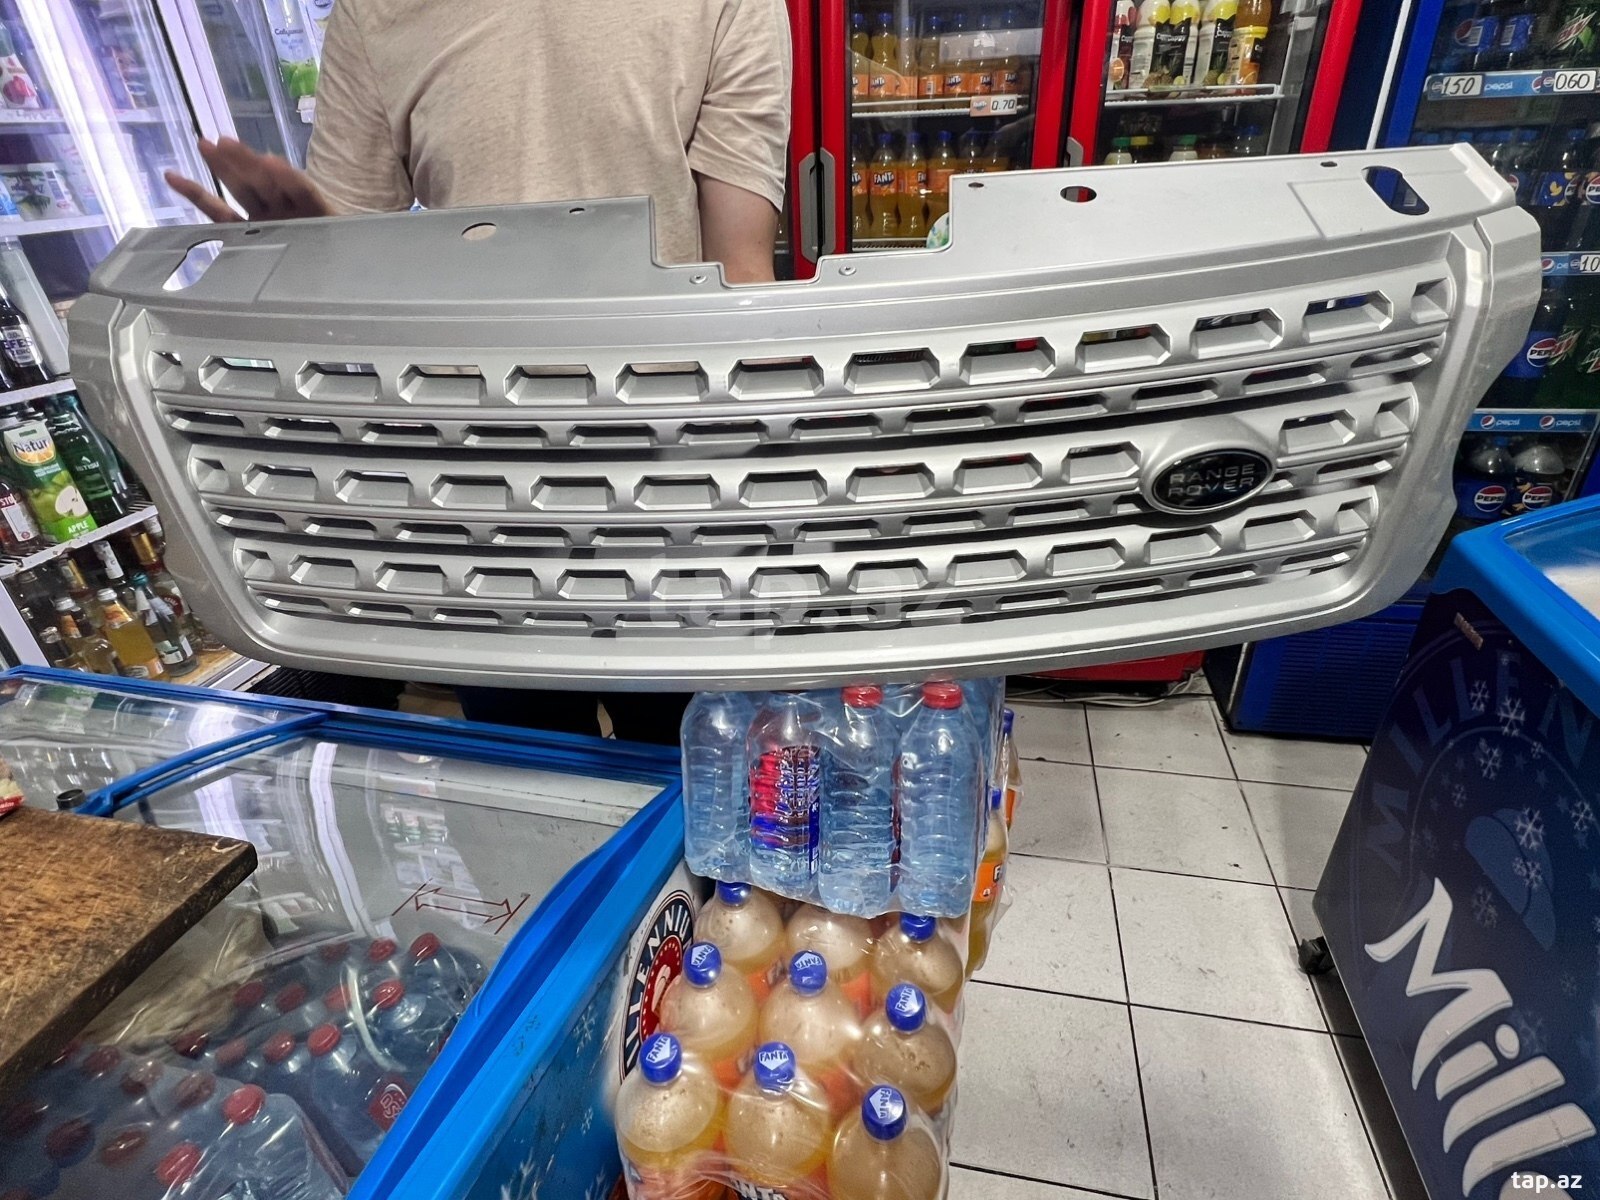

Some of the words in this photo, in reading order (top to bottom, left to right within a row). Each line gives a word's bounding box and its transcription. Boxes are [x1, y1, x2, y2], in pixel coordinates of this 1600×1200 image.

[1484, 82, 1513, 92] pepsi
[12, 437, 49, 454] Natur
[1169, 463, 1256, 485] RANGE
[1168, 476, 1255, 498] ROVER
[67, 520, 89, 534] APPLE
[646, 1035, 670, 1063] FANTA
[759, 1050, 789, 1062] FANTA
